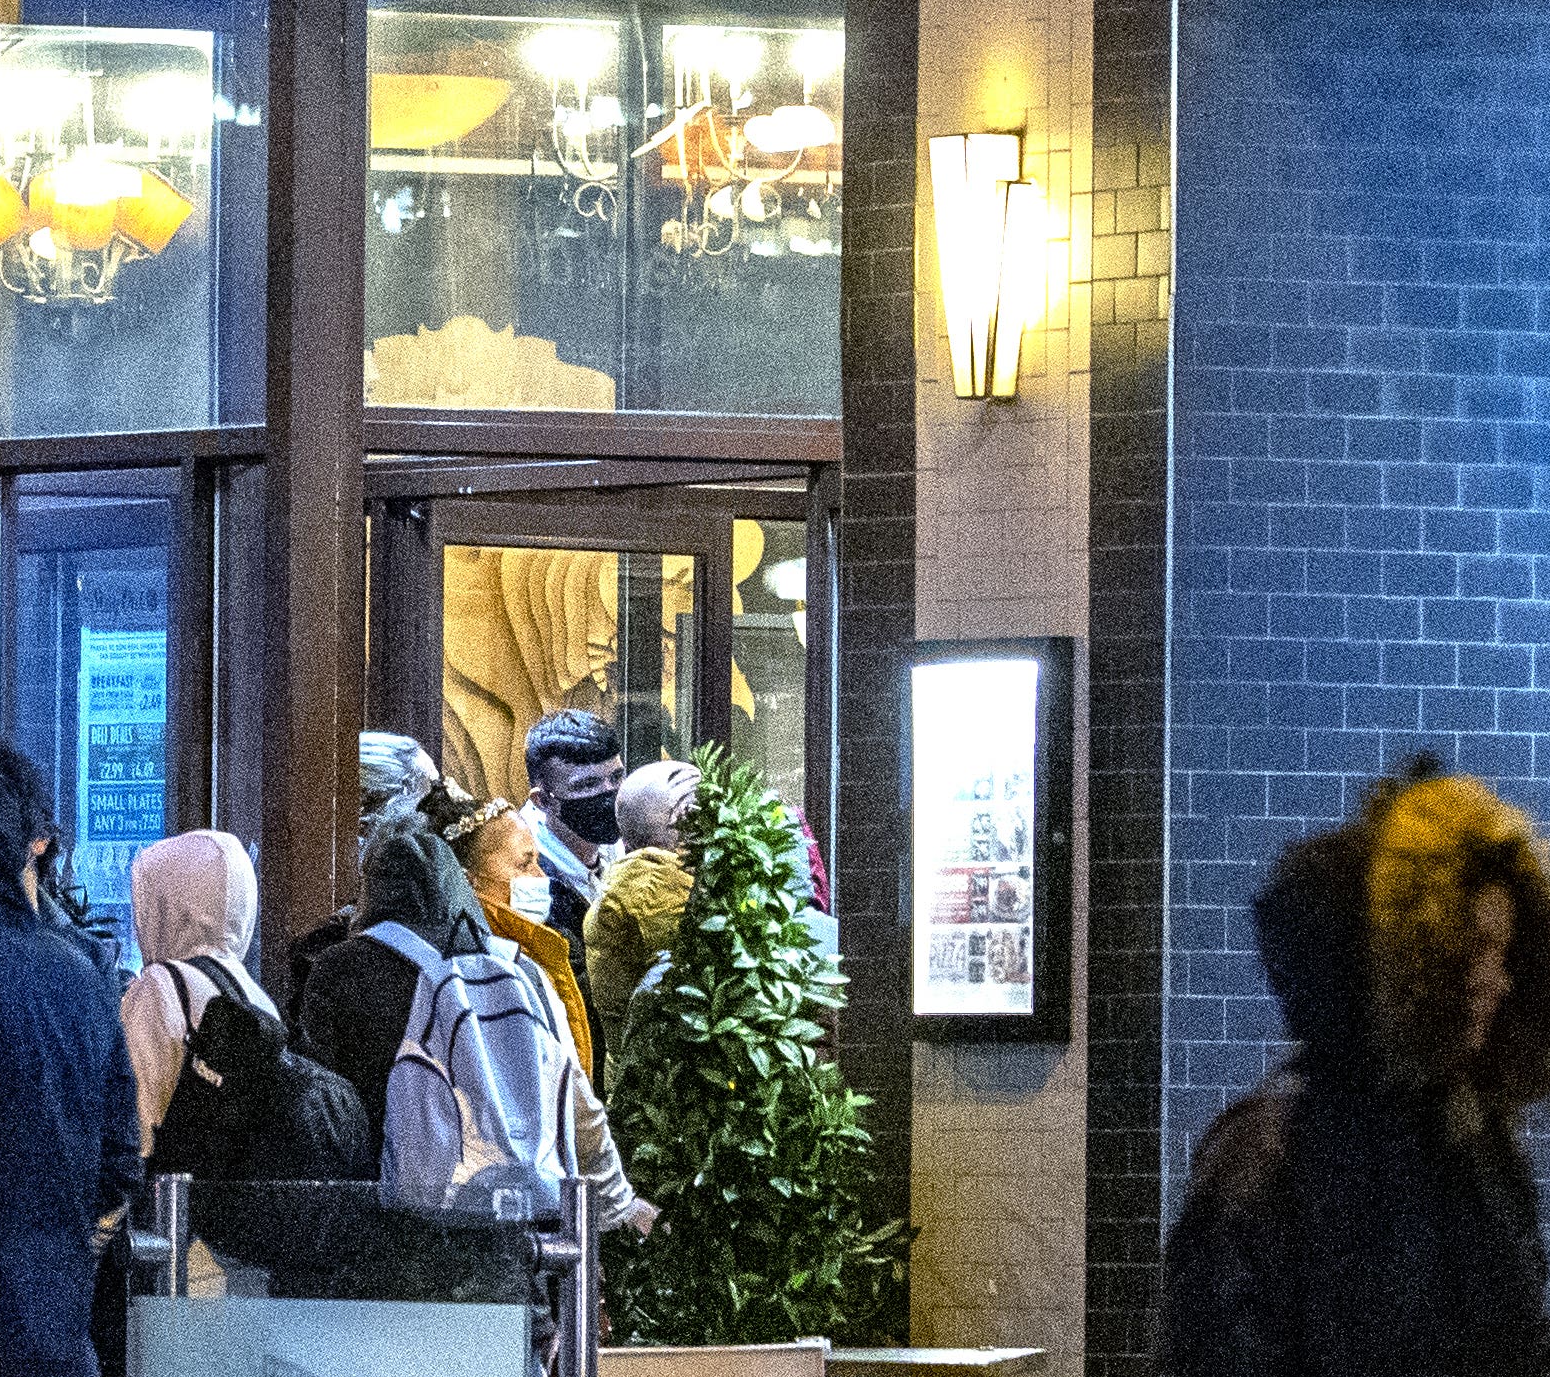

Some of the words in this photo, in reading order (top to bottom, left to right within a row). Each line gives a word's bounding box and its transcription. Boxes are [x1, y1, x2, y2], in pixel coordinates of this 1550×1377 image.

[90, 794, 125, 812] SMALL
[127, 793, 163, 811] PLATES
[93, 814, 117, 832] ANY
